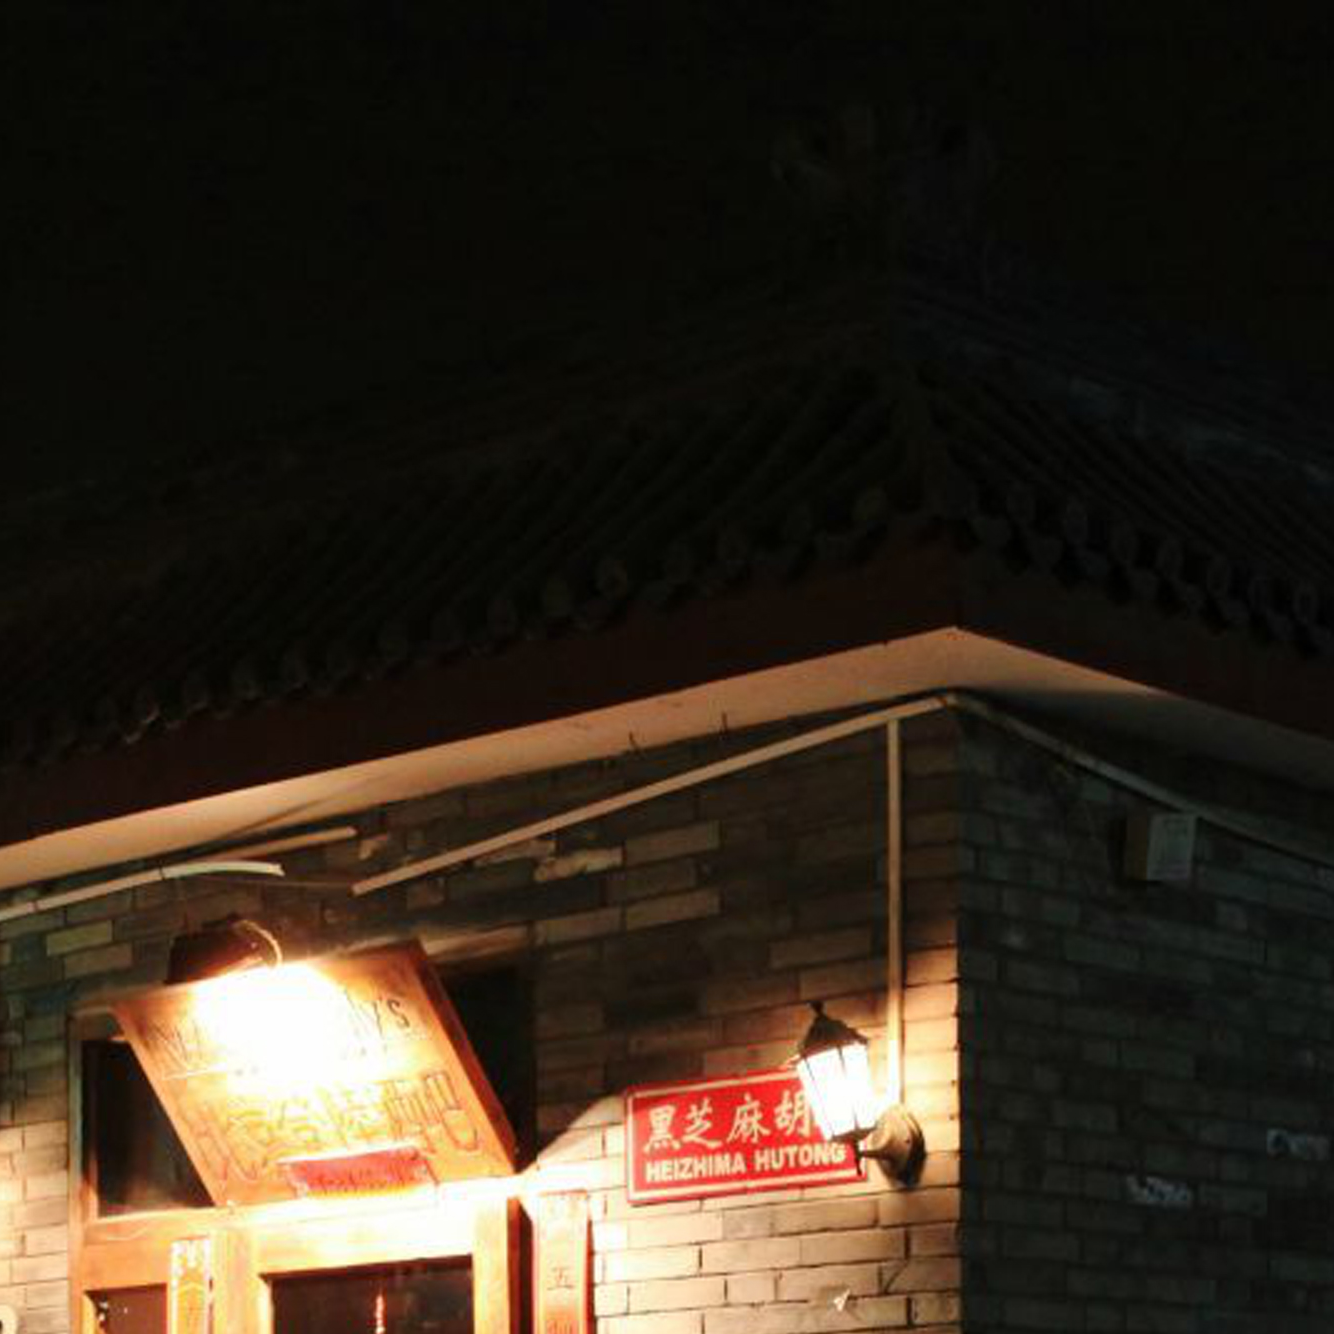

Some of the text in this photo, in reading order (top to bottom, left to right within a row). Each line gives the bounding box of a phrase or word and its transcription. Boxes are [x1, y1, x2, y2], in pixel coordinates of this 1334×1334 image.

[643, 1091, 814, 1153] 黑芝麻胡
[645, 1141, 847, 1184] HEIZHIMA HUTONG
